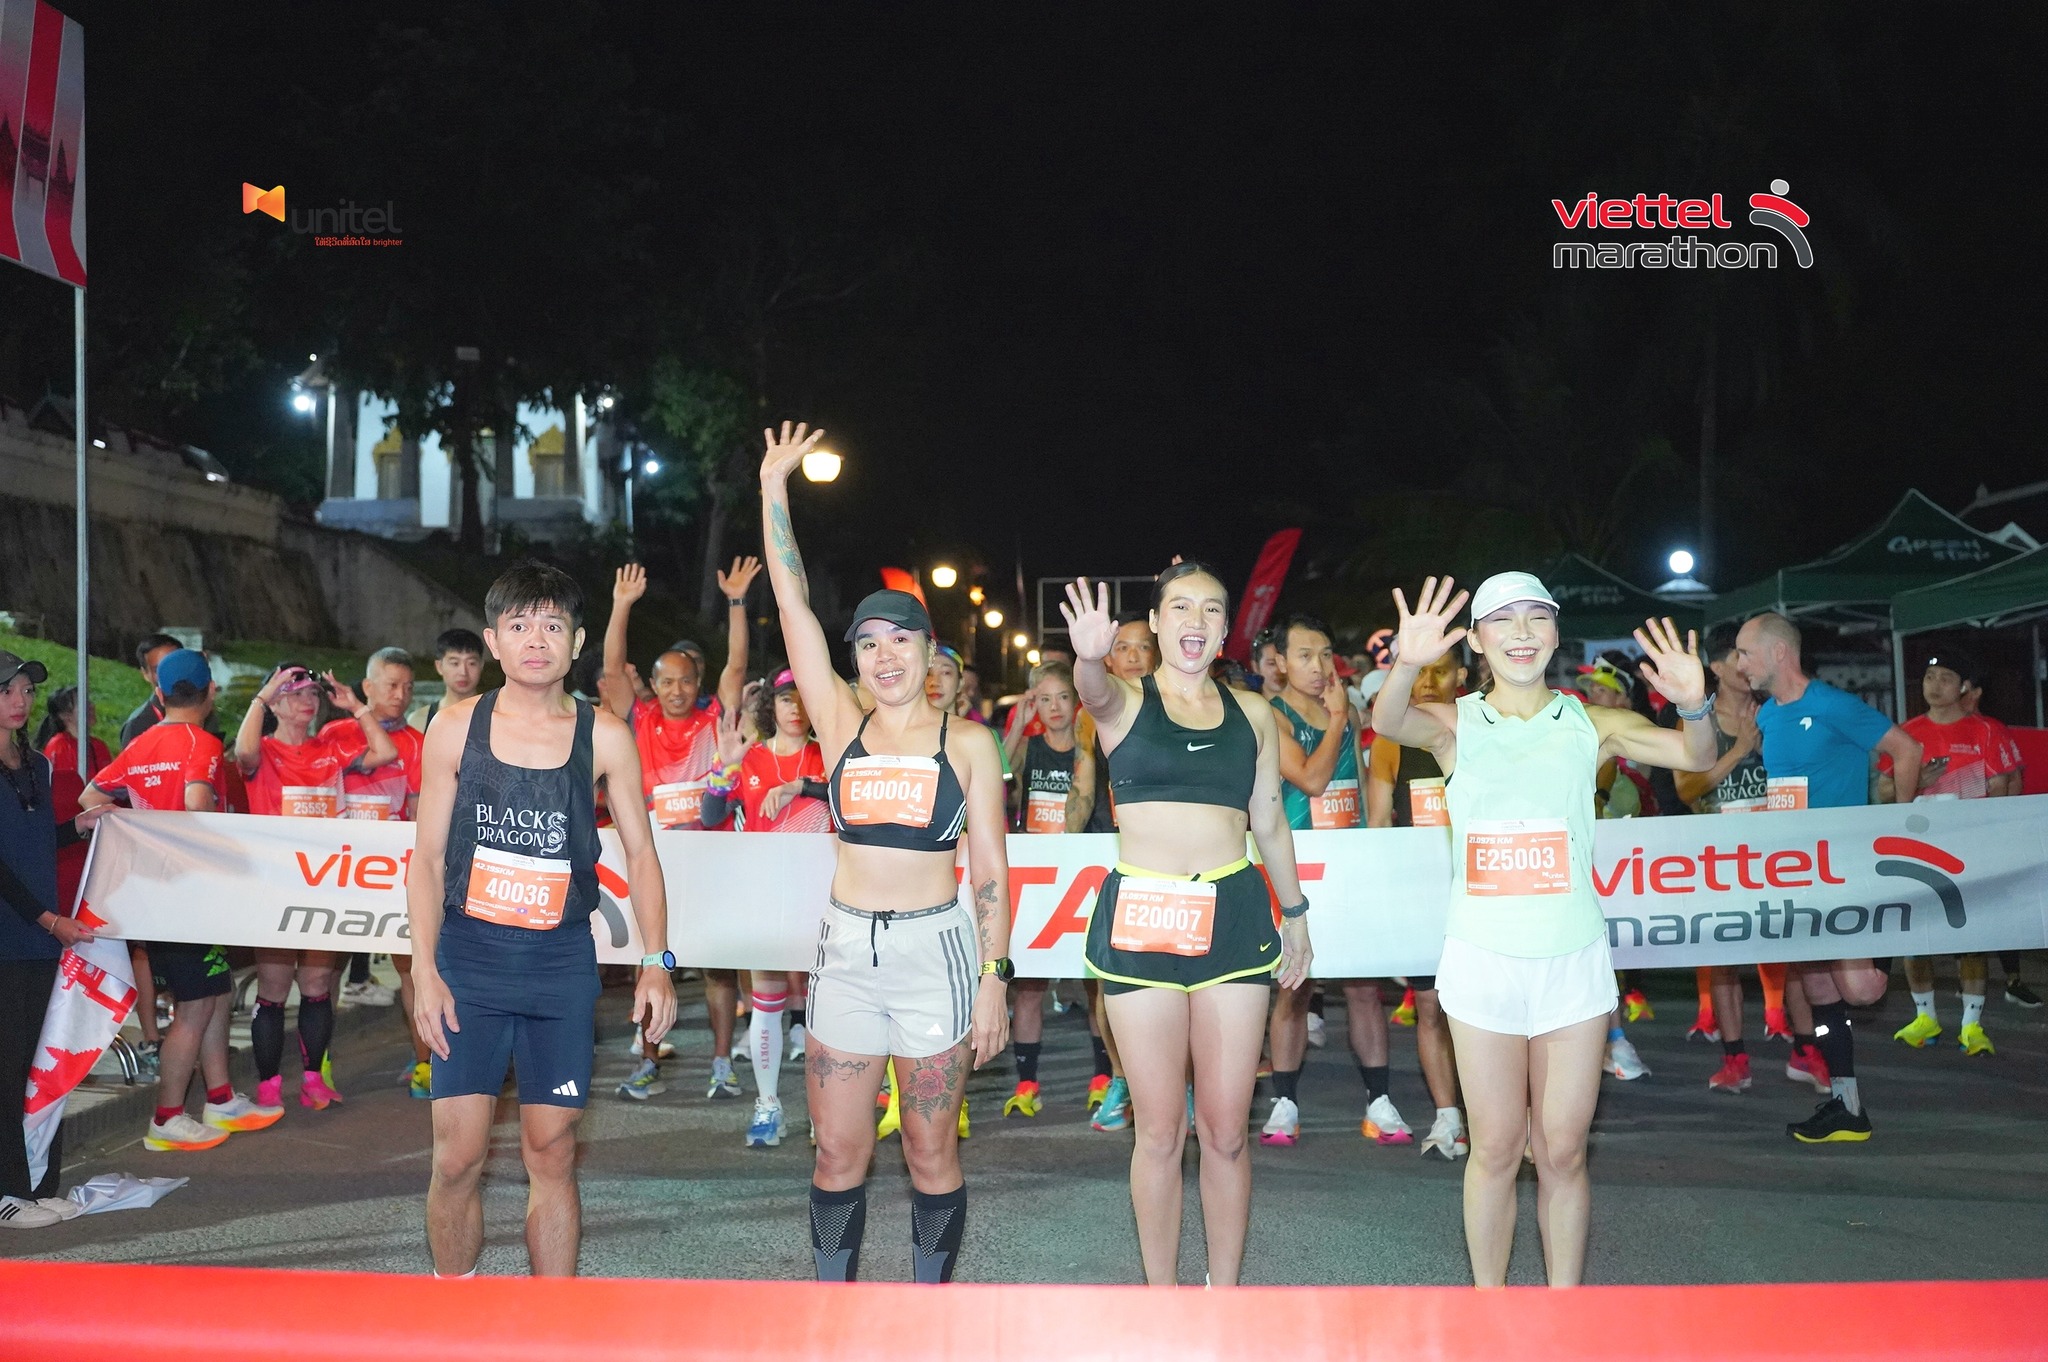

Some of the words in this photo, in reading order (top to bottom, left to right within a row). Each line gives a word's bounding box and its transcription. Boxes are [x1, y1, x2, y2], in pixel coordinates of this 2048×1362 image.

[1030, 781, 1071, 791] DRAGON
[1031, 769, 1070, 781] BLACK
[850, 780, 923, 803] E40004
[293, 801, 327, 815] 25552
[665, 796, 700, 812] 45034
[1323, 797, 1355, 814] 20120
[476, 803, 547, 831] BLACK
[477, 825, 546, 848] DRAGON
[1476, 846, 1555, 871] E25003
[1591, 839, 1846, 897] viettel
[485, 877, 551, 907] 40036
[1124, 903, 1203, 932] E20007
[1605, 899, 1912, 948] marathon
